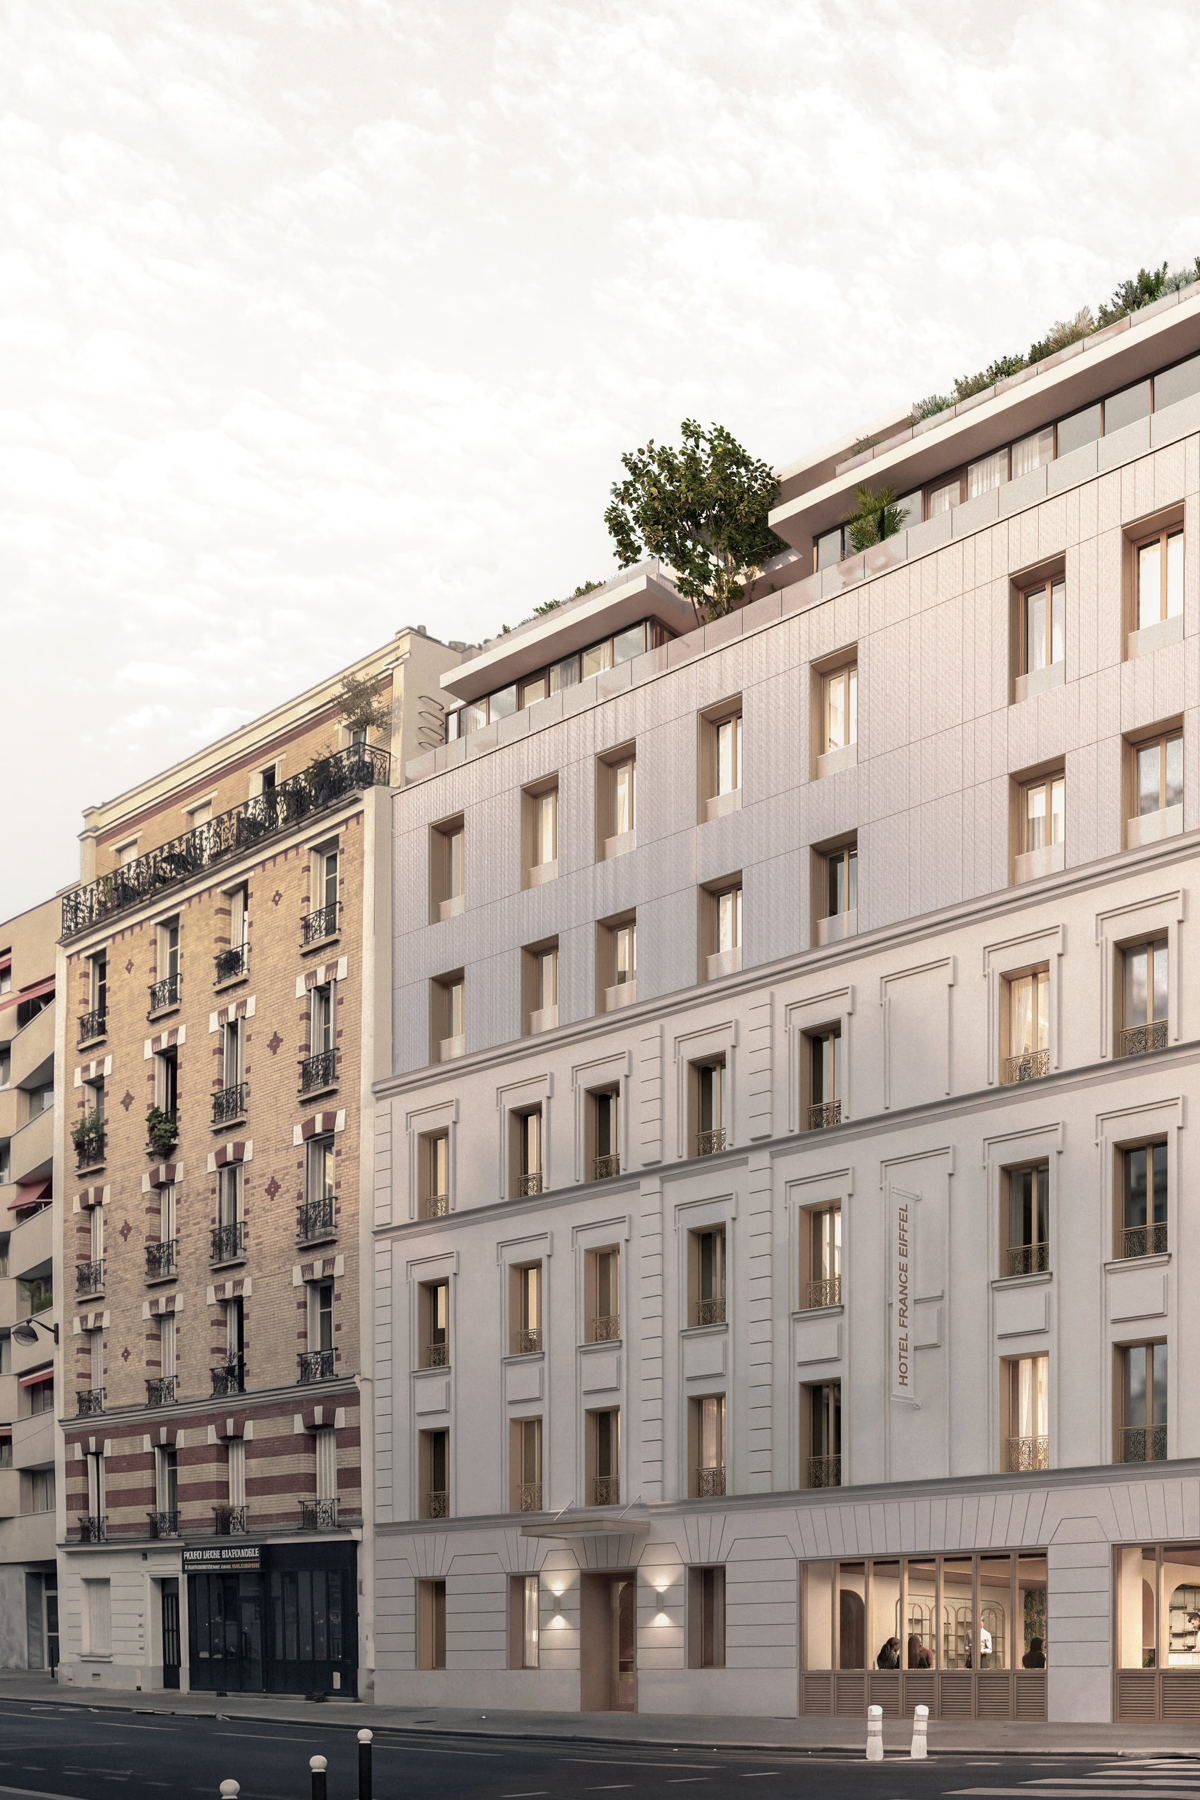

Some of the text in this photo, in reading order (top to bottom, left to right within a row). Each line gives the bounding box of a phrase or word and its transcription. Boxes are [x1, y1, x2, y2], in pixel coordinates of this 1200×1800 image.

[898, 1203, 909, 1386] HOTEL FRANCE EIFFEL
